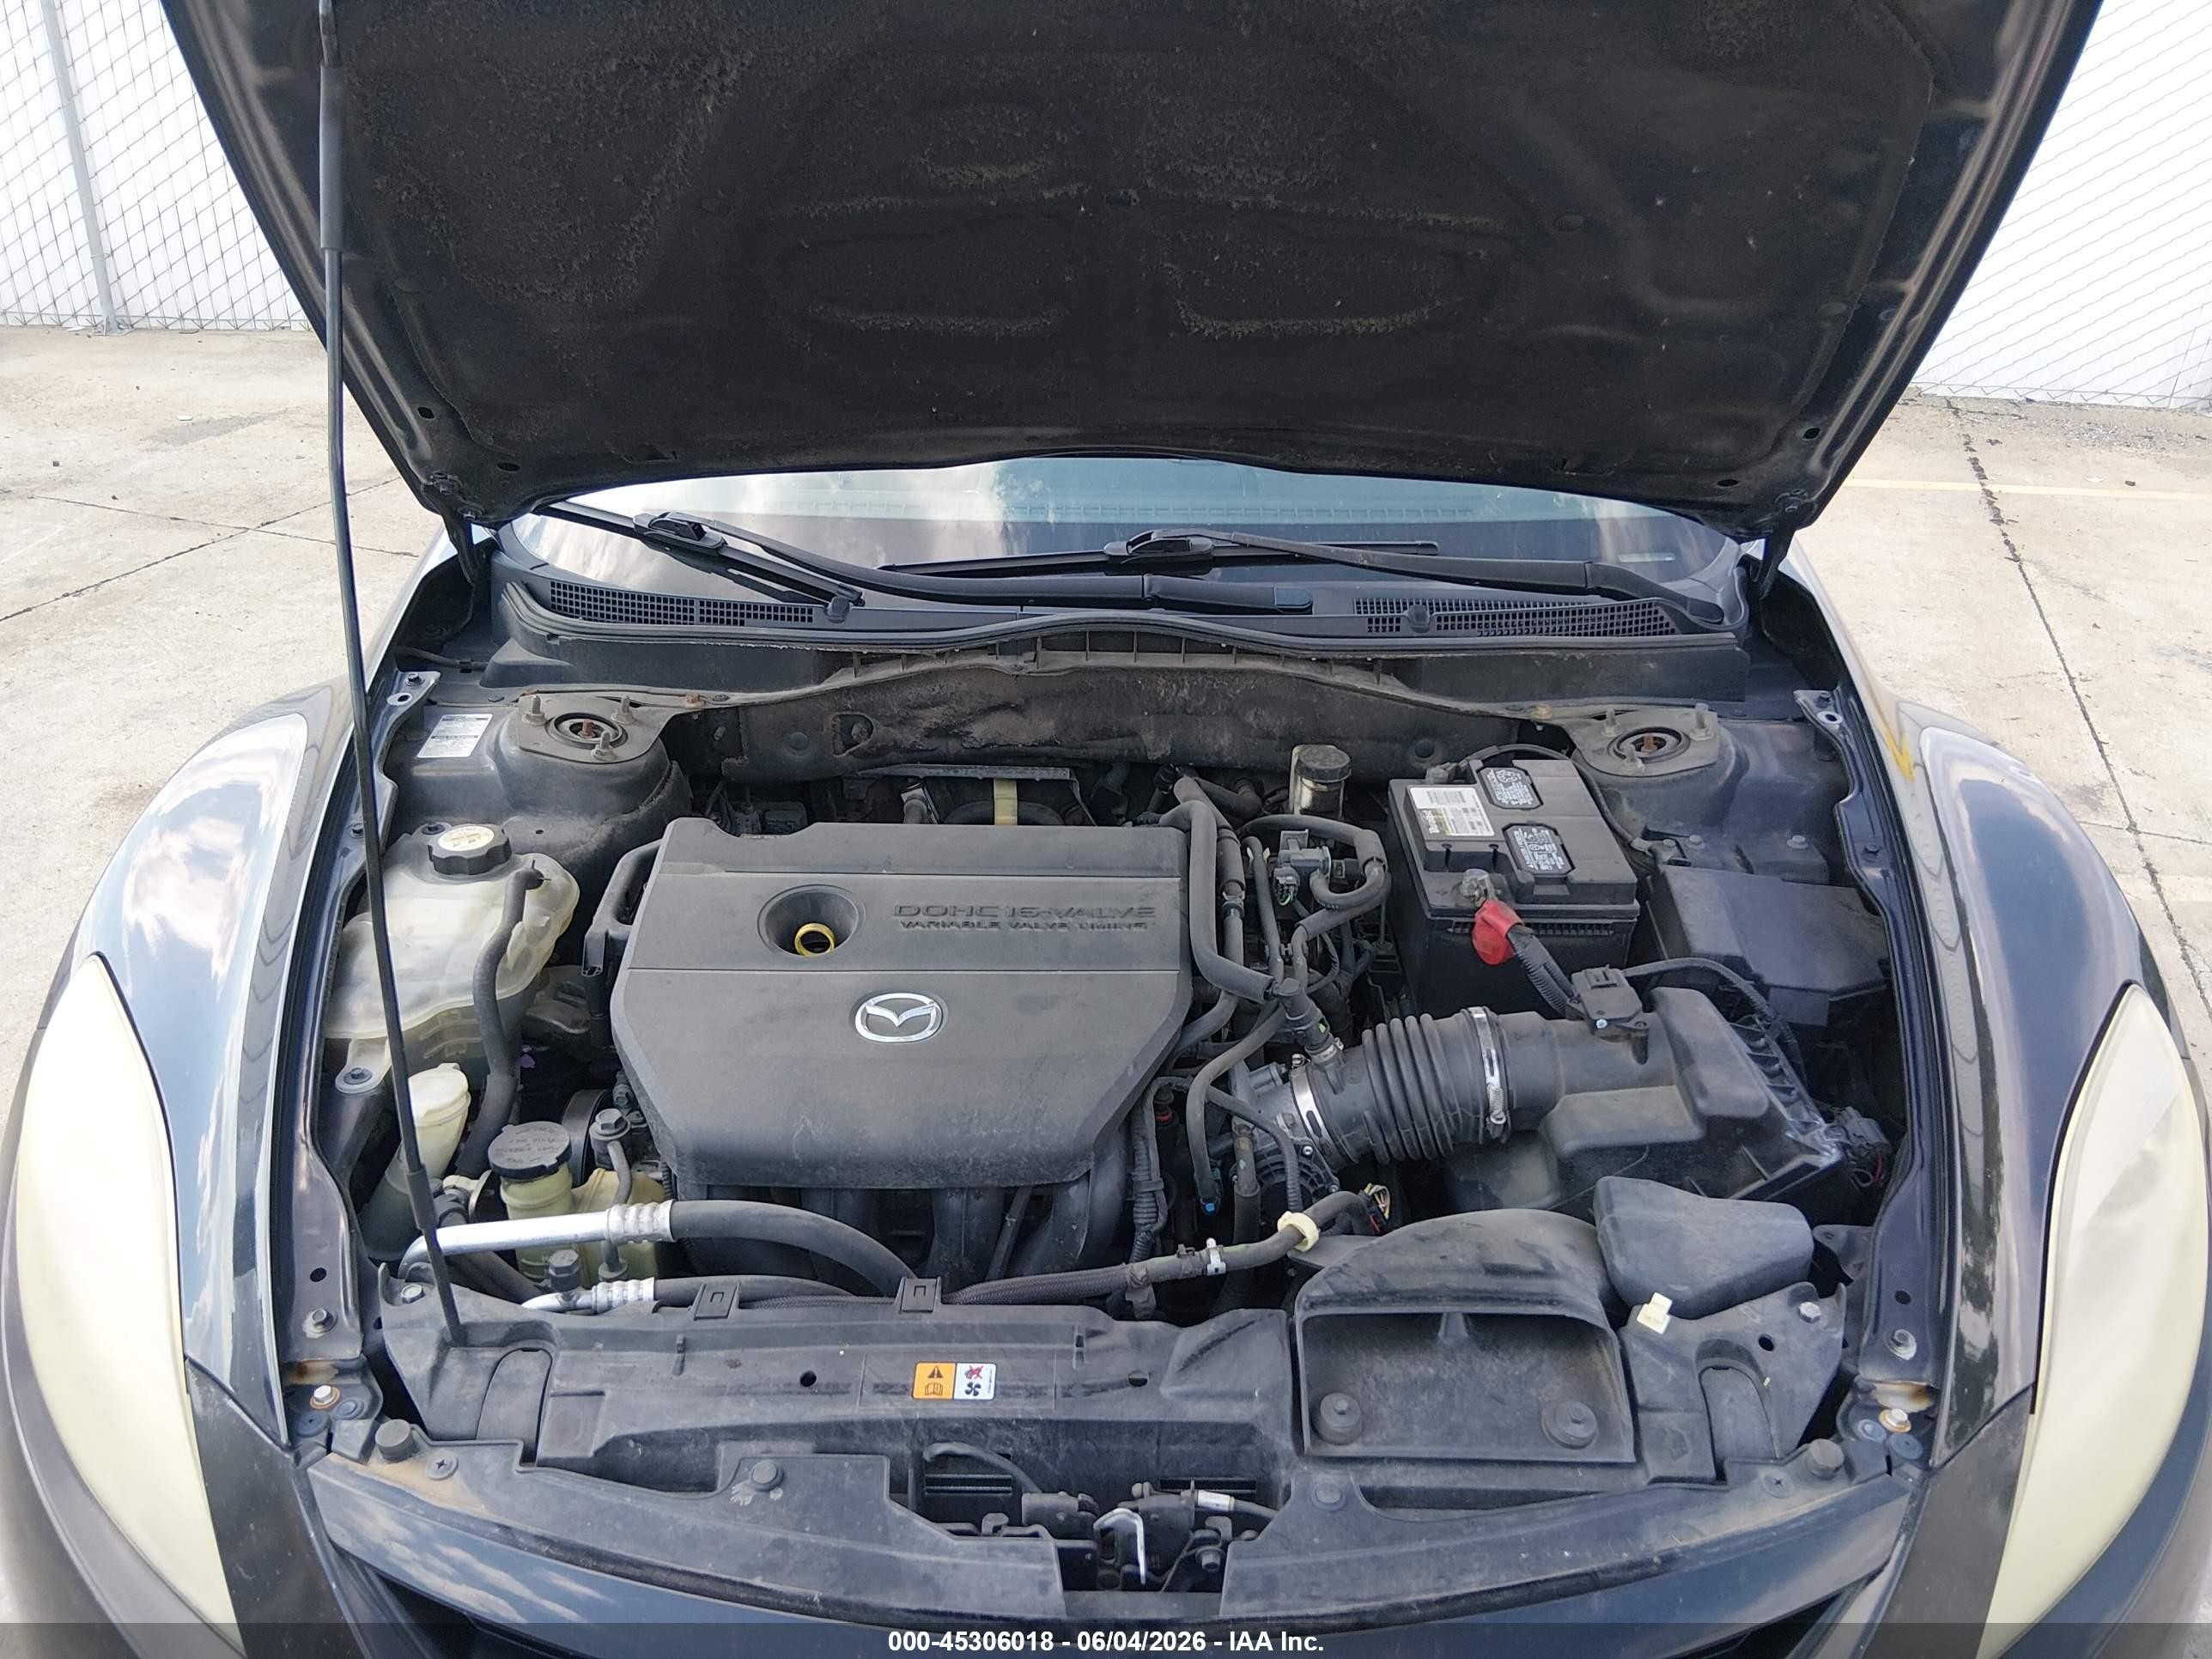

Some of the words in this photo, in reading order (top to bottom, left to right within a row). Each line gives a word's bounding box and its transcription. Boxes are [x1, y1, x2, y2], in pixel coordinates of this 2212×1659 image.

[893, 904, 1000, 918] DOHC
[900, 920, 1001, 930] VARIABLE
[1009, 921, 1069, 931] VALVE
